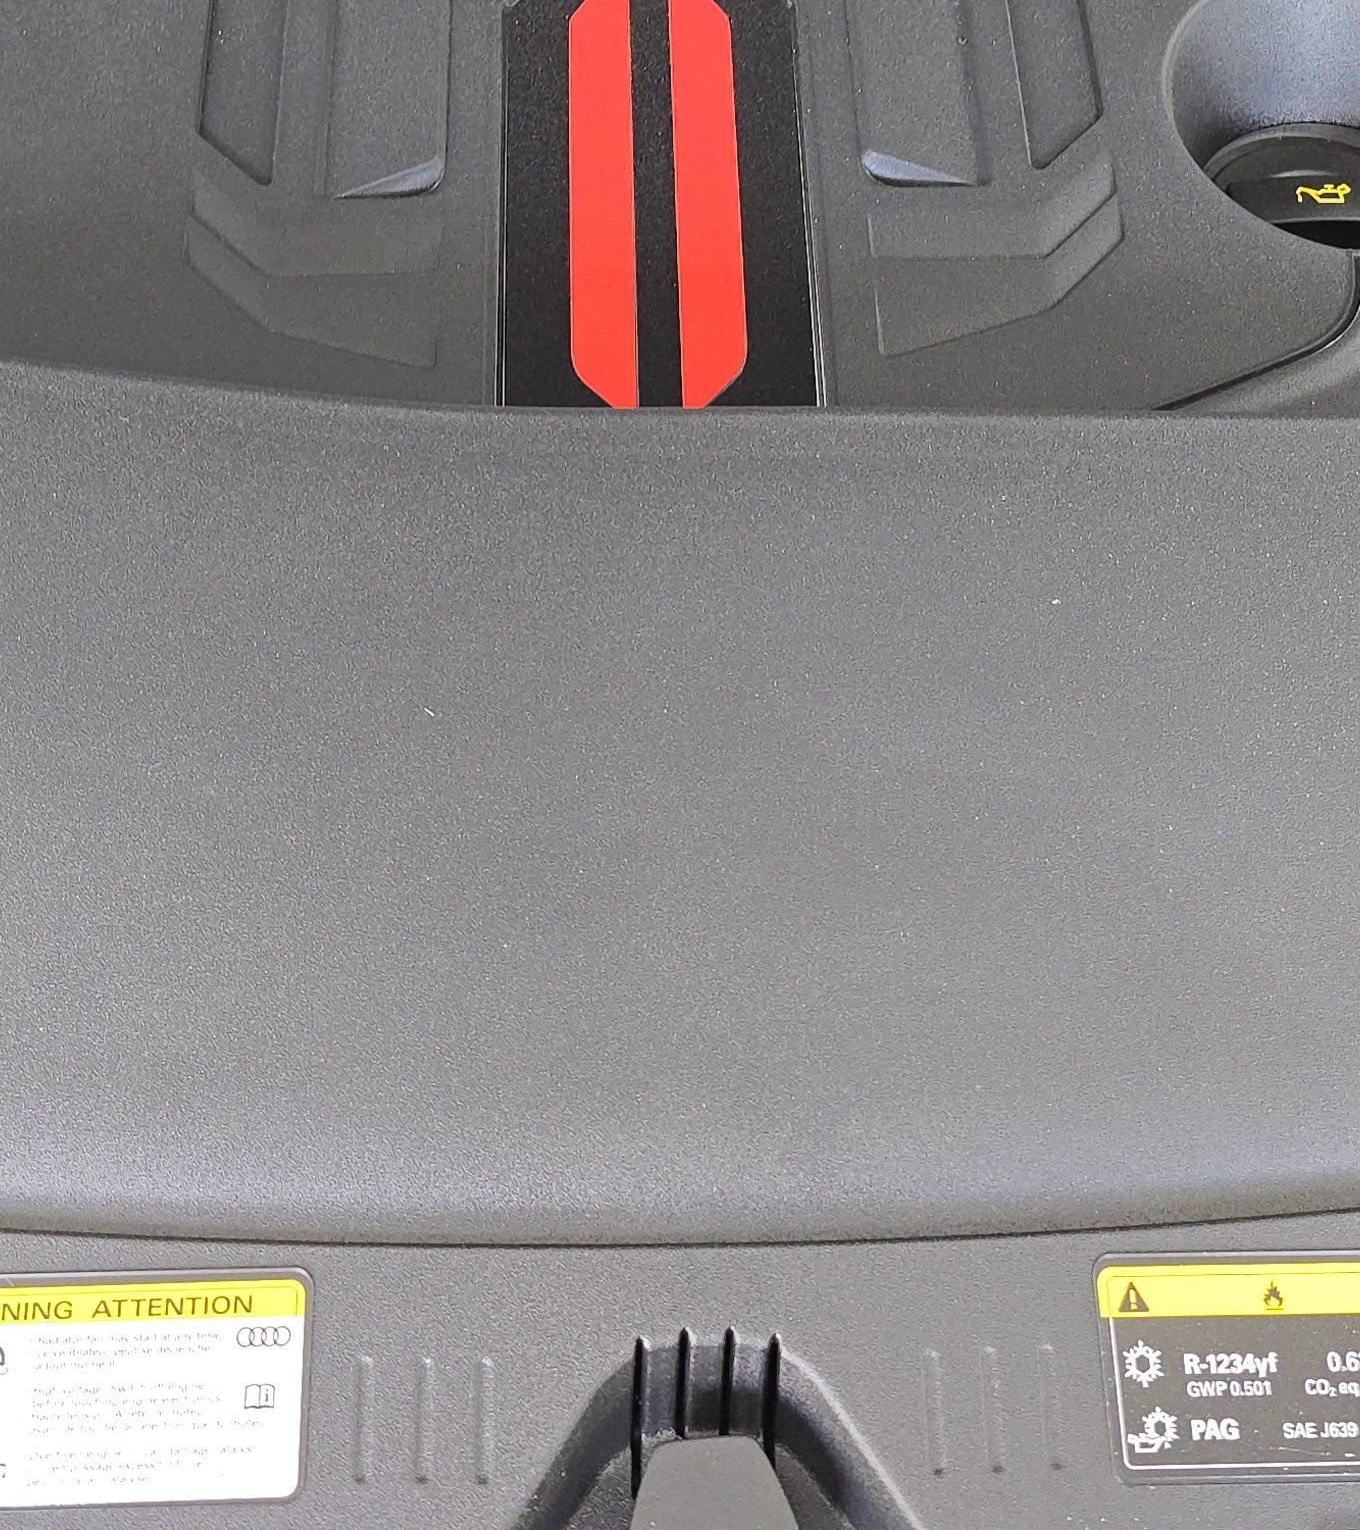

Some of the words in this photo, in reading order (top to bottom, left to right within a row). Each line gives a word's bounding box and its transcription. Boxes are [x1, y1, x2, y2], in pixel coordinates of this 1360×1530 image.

[92, 1294, 254, 1319] ATTENTION
[1183, 1352, 1279, 1377] R-1234yf
[1186, 1381, 1227, 1397] GWP
[1231, 1380, 1272, 1397] 0.501
[1339, 1381, 1360, 1398] eq
[1191, 1418, 1241, 1440] PAG
[1283, 1423, 1317, 1439] SAE
[1320, 1421, 1358, 1438] J639
